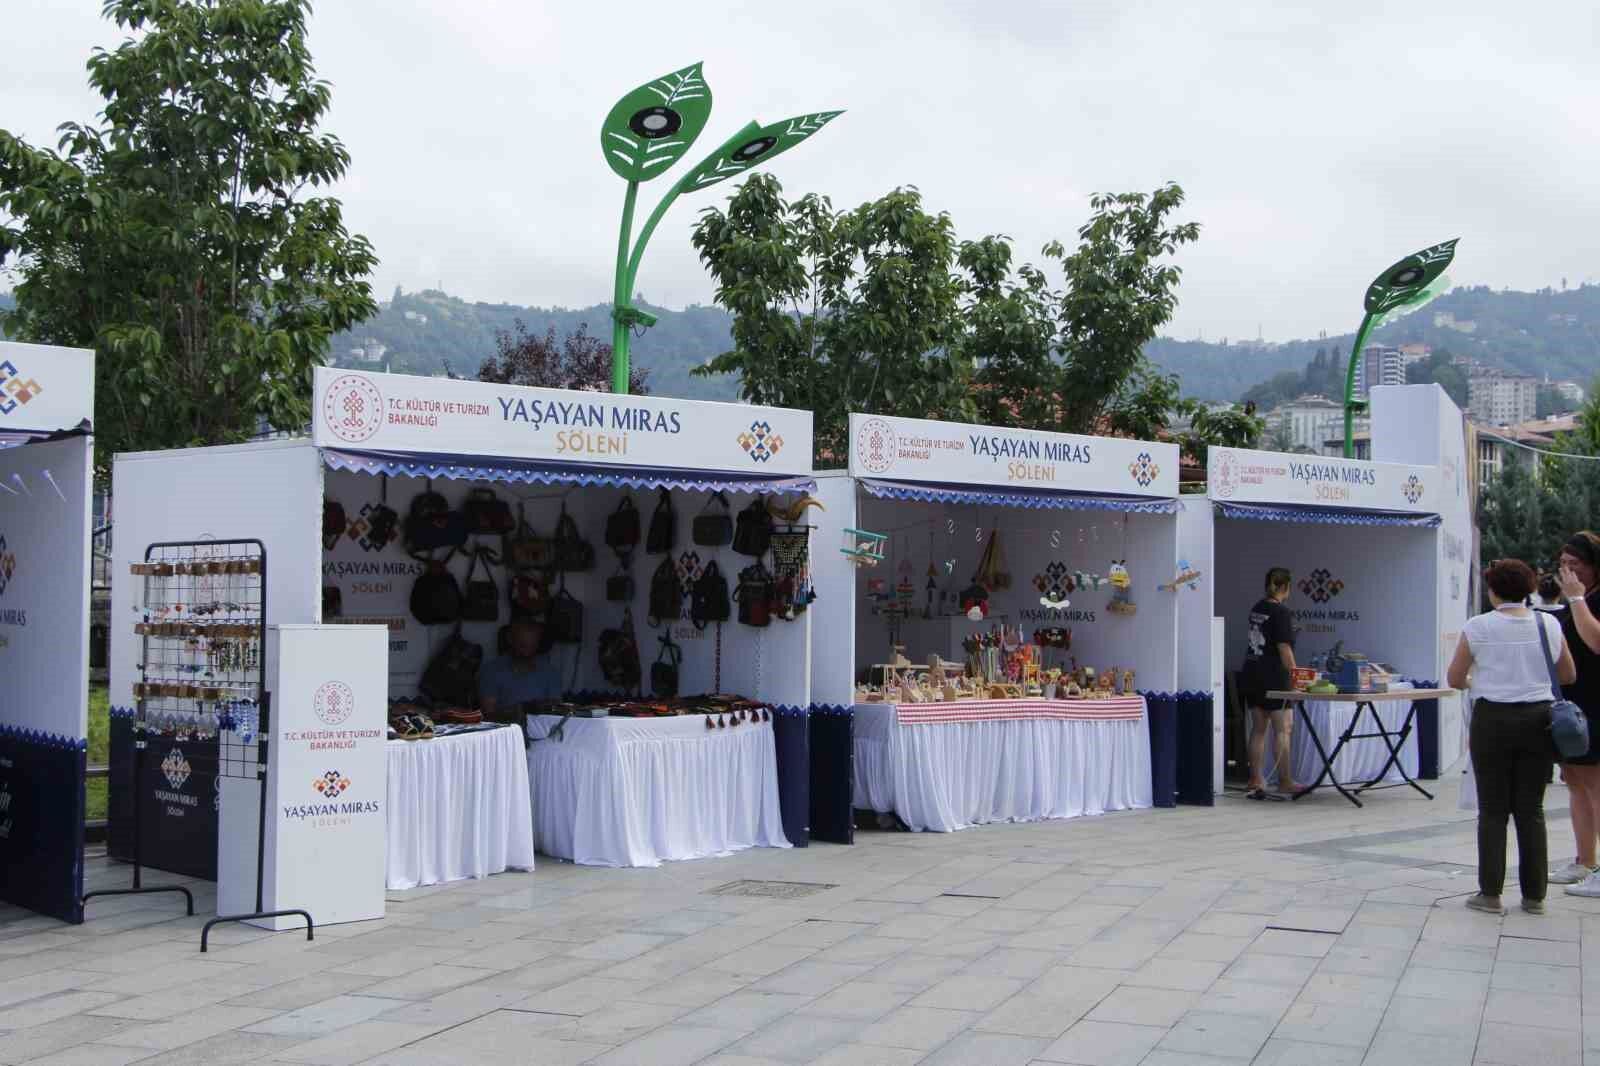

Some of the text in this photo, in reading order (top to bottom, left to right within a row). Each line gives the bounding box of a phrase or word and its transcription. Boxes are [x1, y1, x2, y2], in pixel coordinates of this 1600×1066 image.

[388, 398, 490, 416] T.C. KÜLTÜR VE TURİZM
[498, 397, 681, 434] YAŞAYAN MİRAS
[388, 413, 438, 428] BAKANLIĞI
[556, 430, 628, 455] ŞÖLENİ
[935, 440, 943, 449] VE
[969, 434, 1091, 464] YAŞAYAN MİRAS
[1289, 462, 1339, 485] YAŞAYAN
[1018, 608, 1062, 624] YAŞAYN
[337, 730, 347, 739] VE
[284, 804, 338, 821] YAŞAYAN
